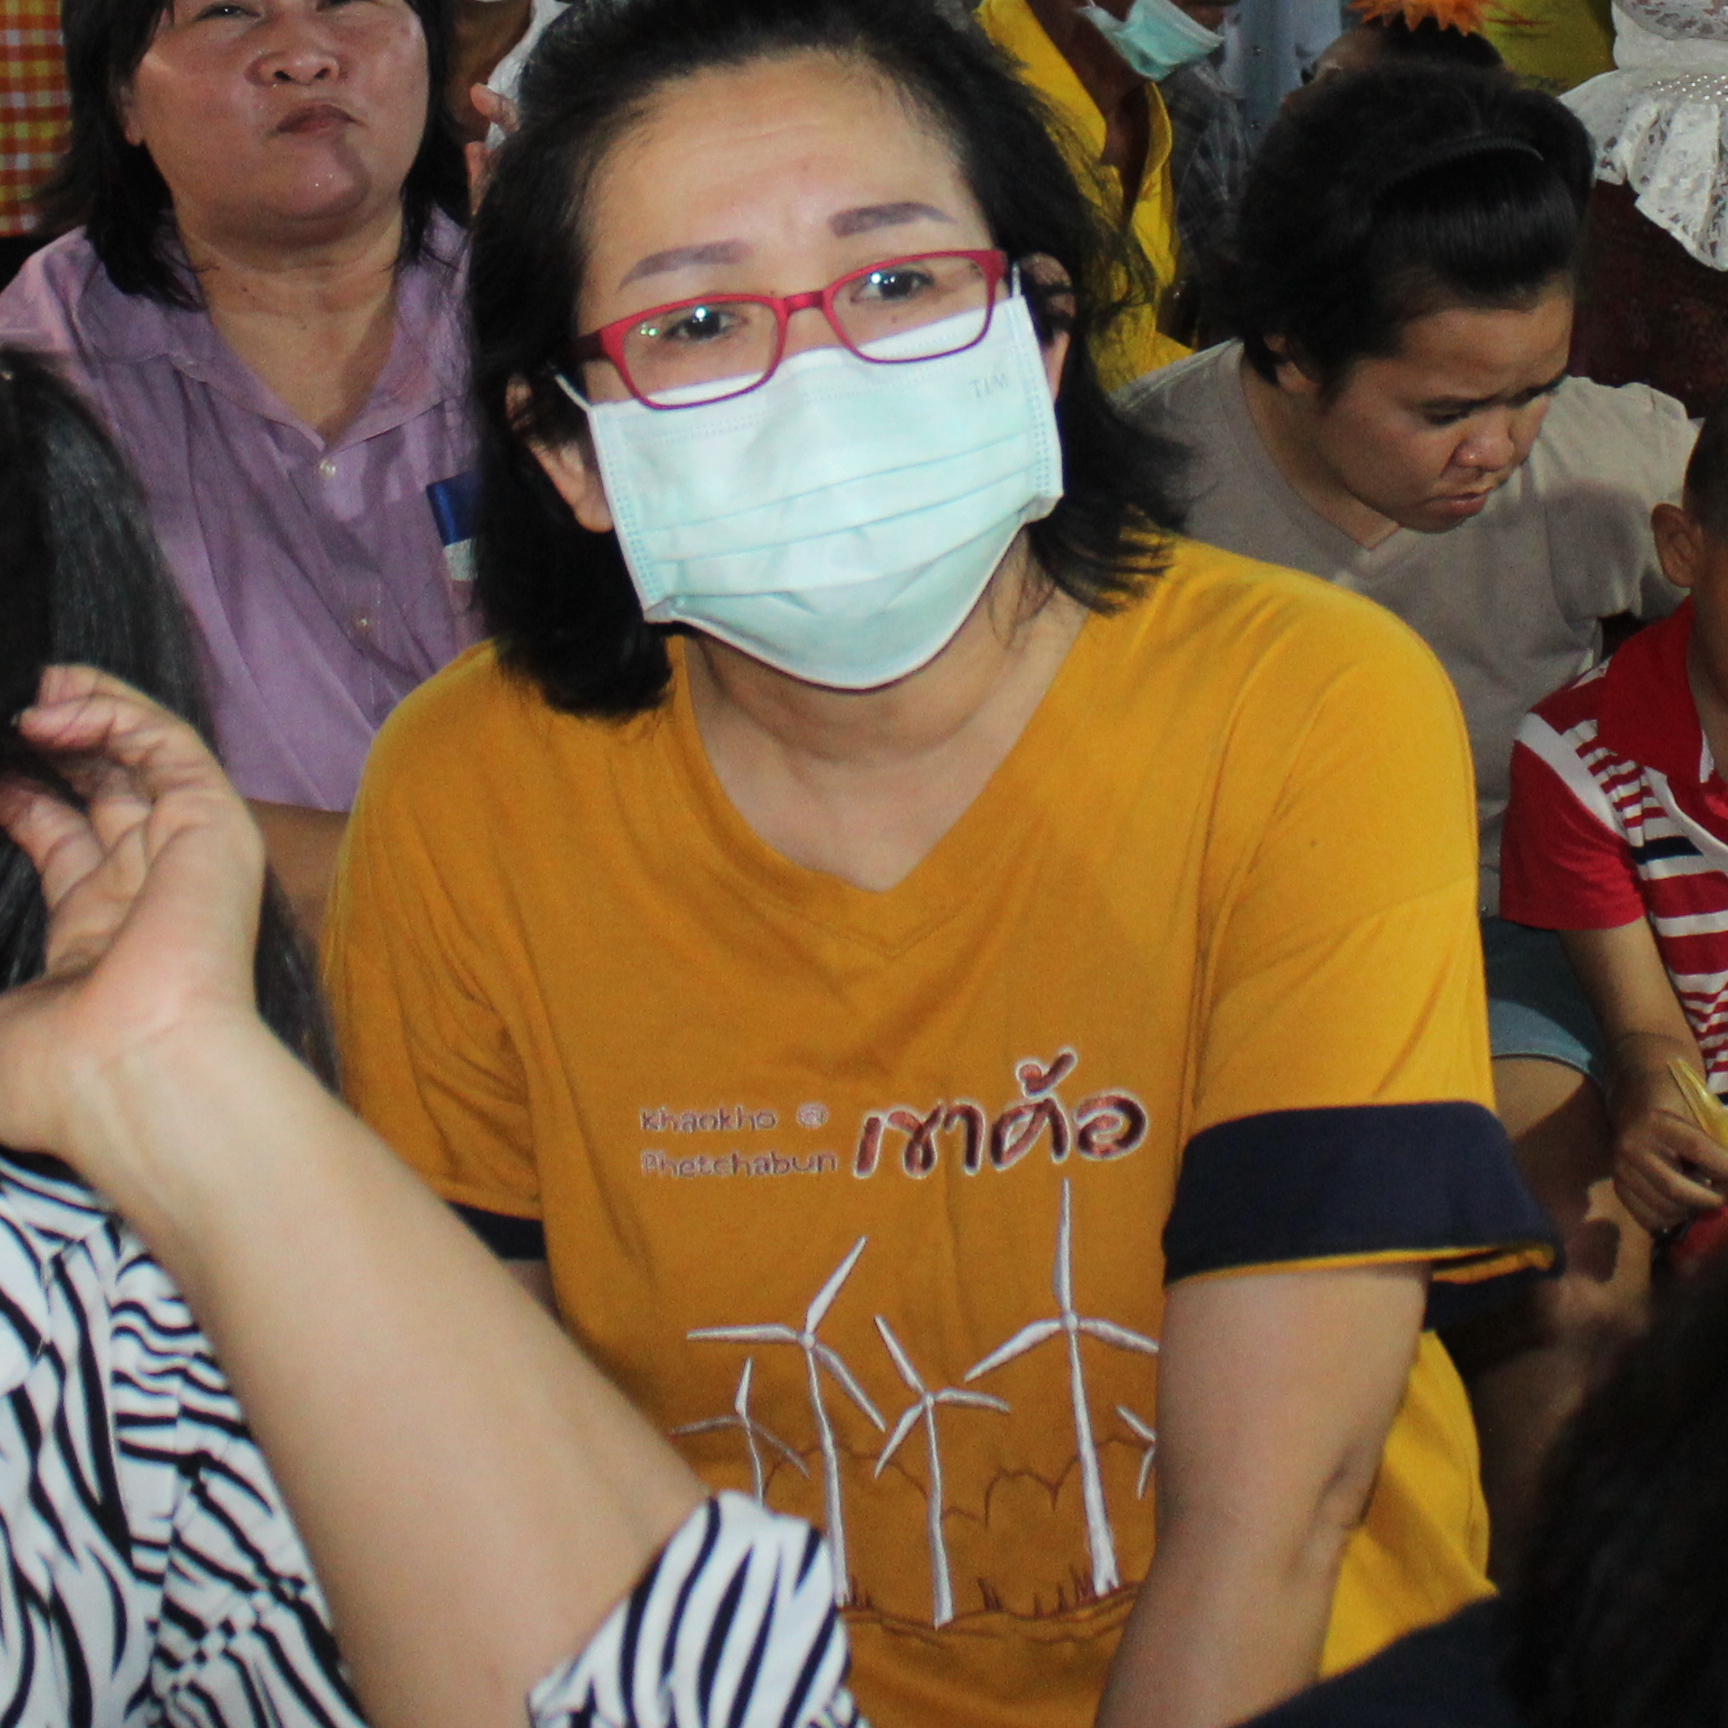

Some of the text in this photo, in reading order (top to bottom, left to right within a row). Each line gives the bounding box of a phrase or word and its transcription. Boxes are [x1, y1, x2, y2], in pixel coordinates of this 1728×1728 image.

[853, 1045, 1148, 1179] เขาค้อ
[640, 1150, 839, 1178] Phetchabun
